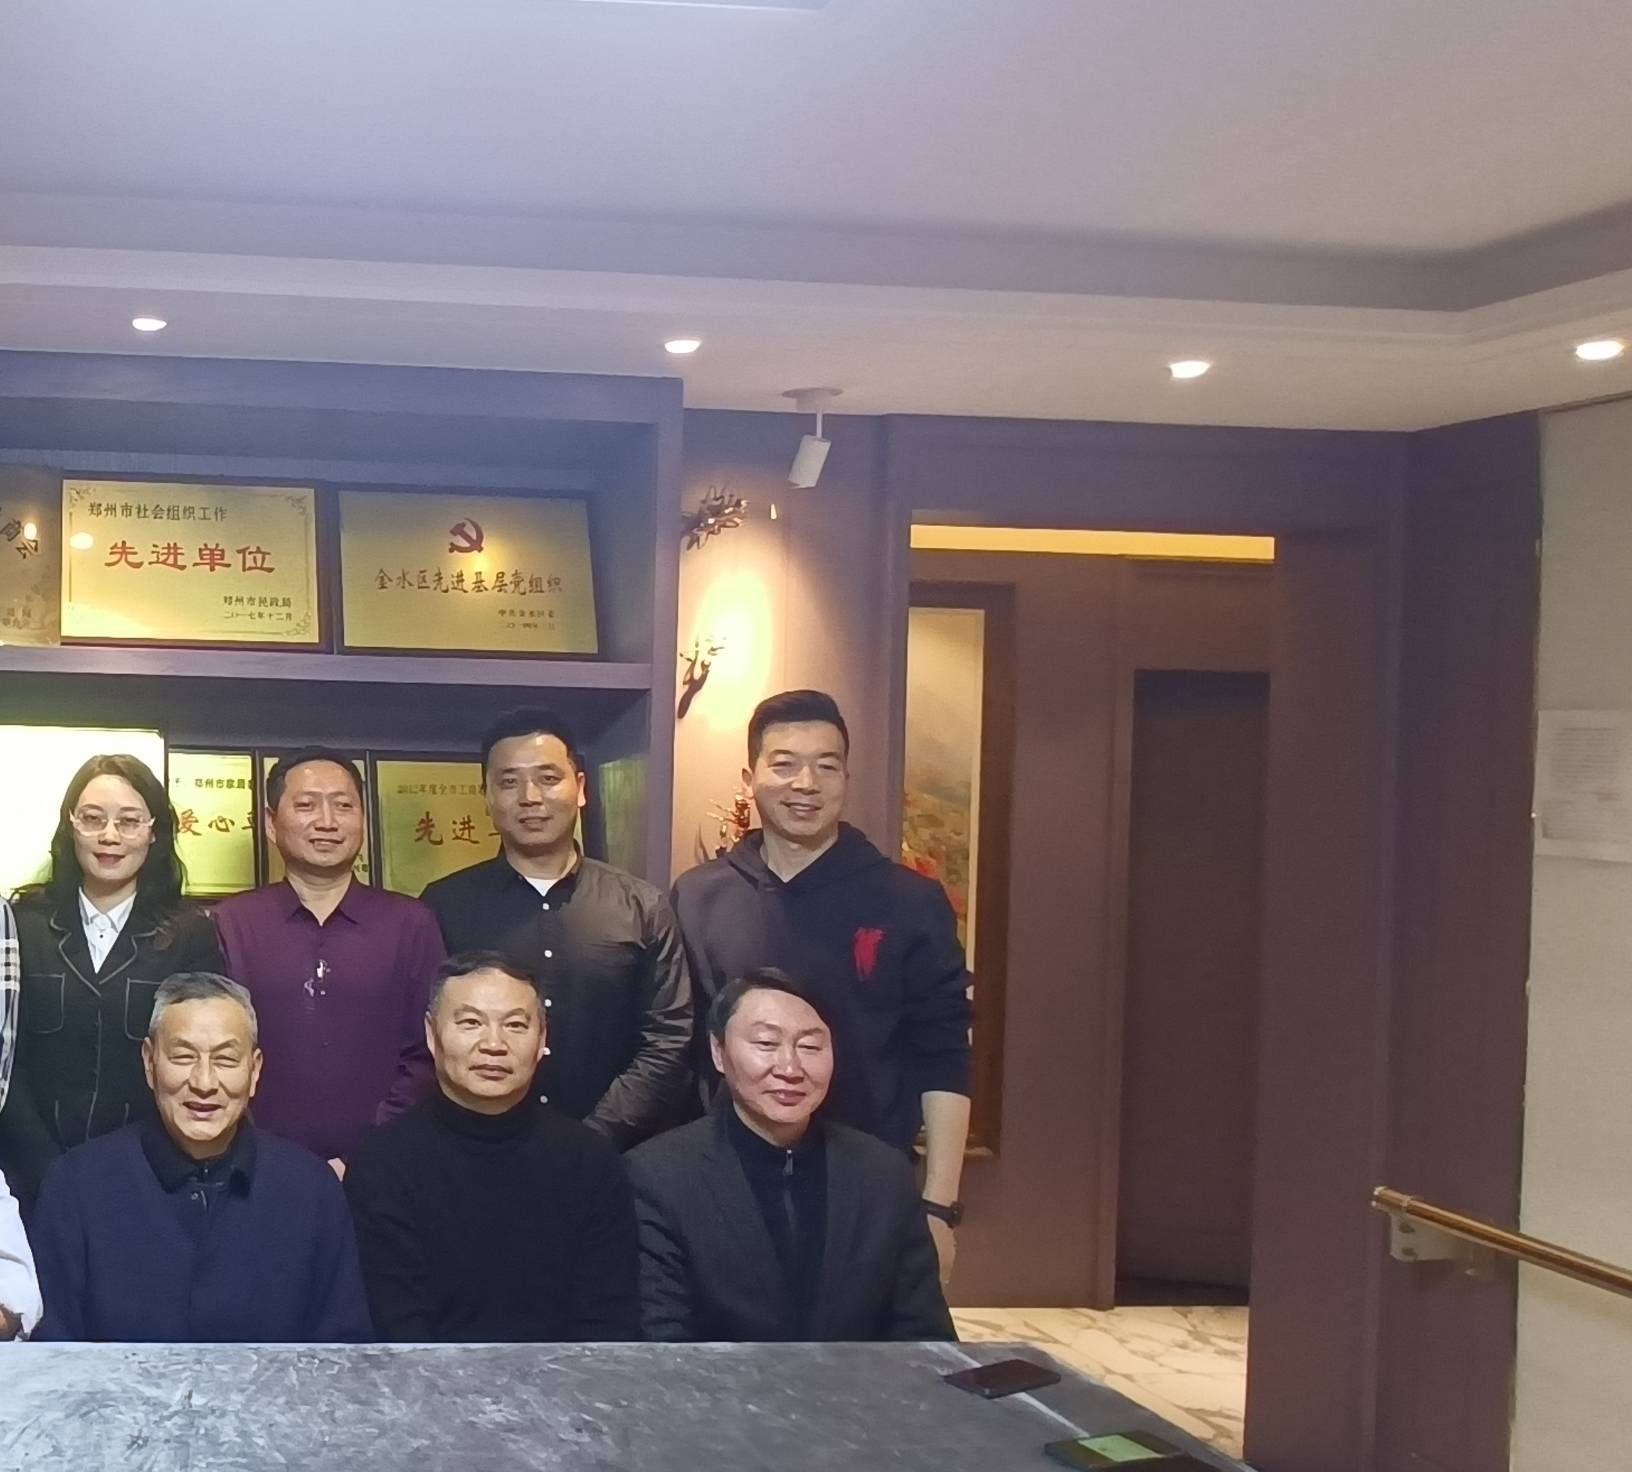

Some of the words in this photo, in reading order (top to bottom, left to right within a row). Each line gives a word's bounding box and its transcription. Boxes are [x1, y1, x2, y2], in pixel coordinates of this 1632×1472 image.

[87, 501, 229, 522] 郑州市社会组织工作
[103, 539, 276, 574] 先进单位
[373, 566, 564, 596] 金水区先进基层党组织
